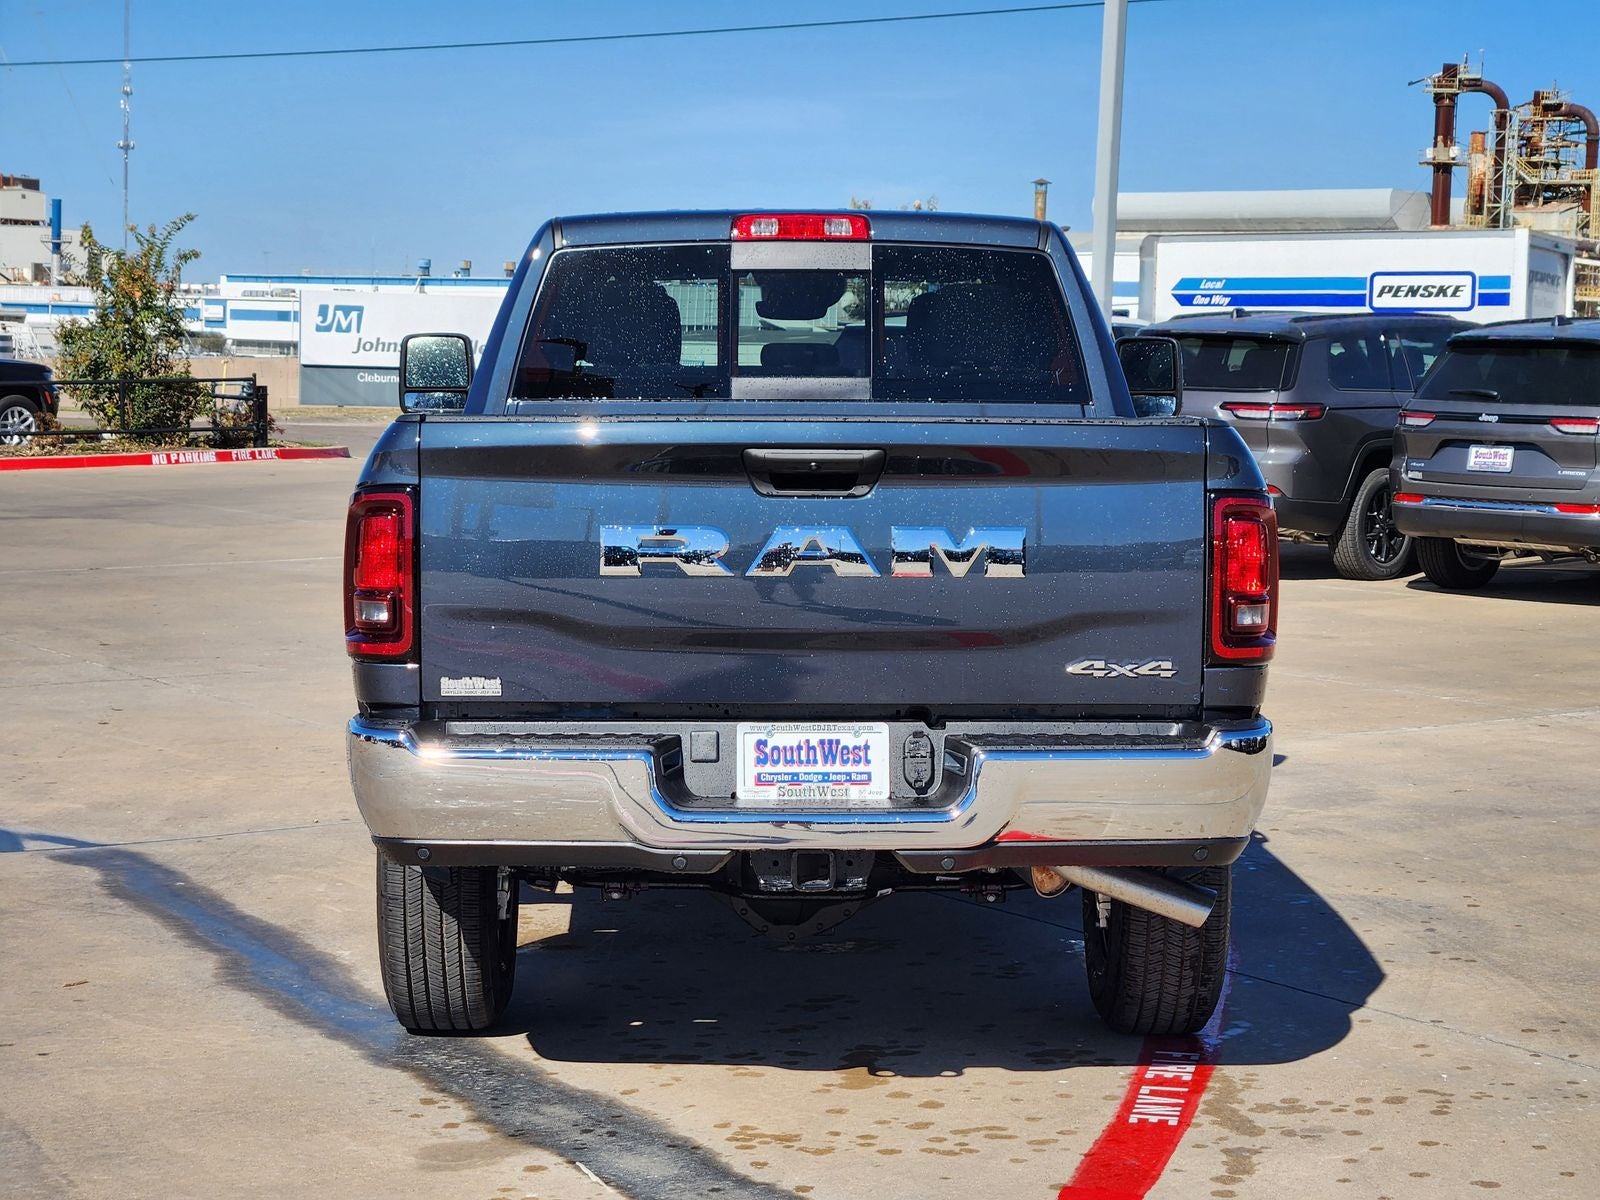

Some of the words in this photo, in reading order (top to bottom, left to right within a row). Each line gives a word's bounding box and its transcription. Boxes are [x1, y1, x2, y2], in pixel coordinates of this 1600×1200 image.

[1199, 279, 1226, 289] Local
[1376, 284, 1467, 298] PENSKE
[1192, 295, 1210, 305] One
[1210, 294, 1231, 307] Way
[315, 304, 364, 334] JM
[352, 337, 401, 354] John
[357, 372, 400, 383] Cleburn
[1478, 413, 1499, 423] Jeep
[151, 453, 168, 465] NO
[170, 451, 217, 464] PARKING
[231, 449, 252, 460] FIRE
[254, 448, 279, 460] LANE
[599, 524, 1026, 578] RAM
[1065, 656, 1177, 679] 4x4
[754, 738, 872, 767] SouthWest
[760, 773, 792, 783] Chrysler
[799, 773, 823, 783] Dodge
[828, 773, 846, 783] Jeep
[851, 773, 868, 781] Ram
[777, 785, 849, 798] SouthWest
[1128, 1085, 1189, 1126] LANE
